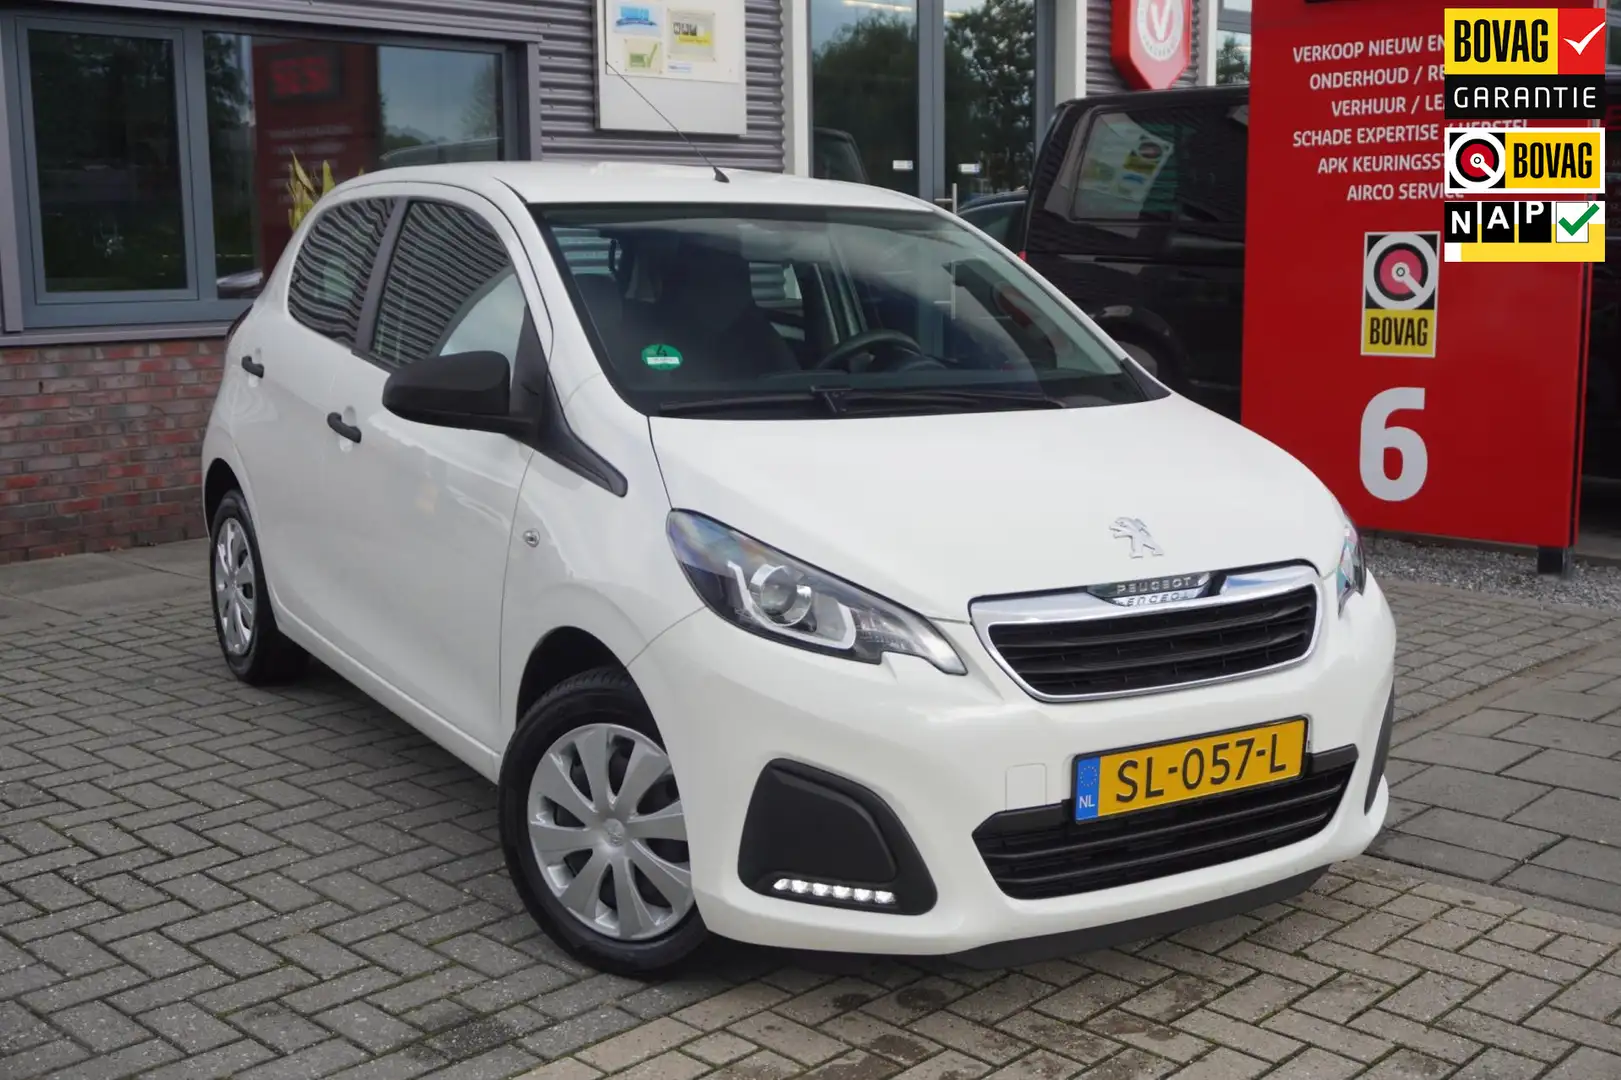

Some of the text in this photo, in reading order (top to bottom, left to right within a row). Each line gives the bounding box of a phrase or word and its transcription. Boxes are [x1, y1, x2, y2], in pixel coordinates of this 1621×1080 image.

[1293, 41, 1364, 63] VERKOOP
[1368, 36, 1424, 57] NIEUW
[1310, 67, 1409, 90] ONDERHOUD
[1331, 96, 1406, 117] VERHUUR
[1425, 94, 1445, 111] LE
[1292, 124, 1439, 148] SCHADE EXPERTISE
[1318, 157, 1348, 174] APK
[1347, 182, 1464, 201] AIRCO SERVI
[1369, 316, 1428, 346] BOVAG
[1359, 386, 1428, 502] 6
[1117, 577, 1191, 594] PEUGEOT
[1116, 734, 1287, 803] SL-057-L
[1079, 796, 1095, 809] NL
